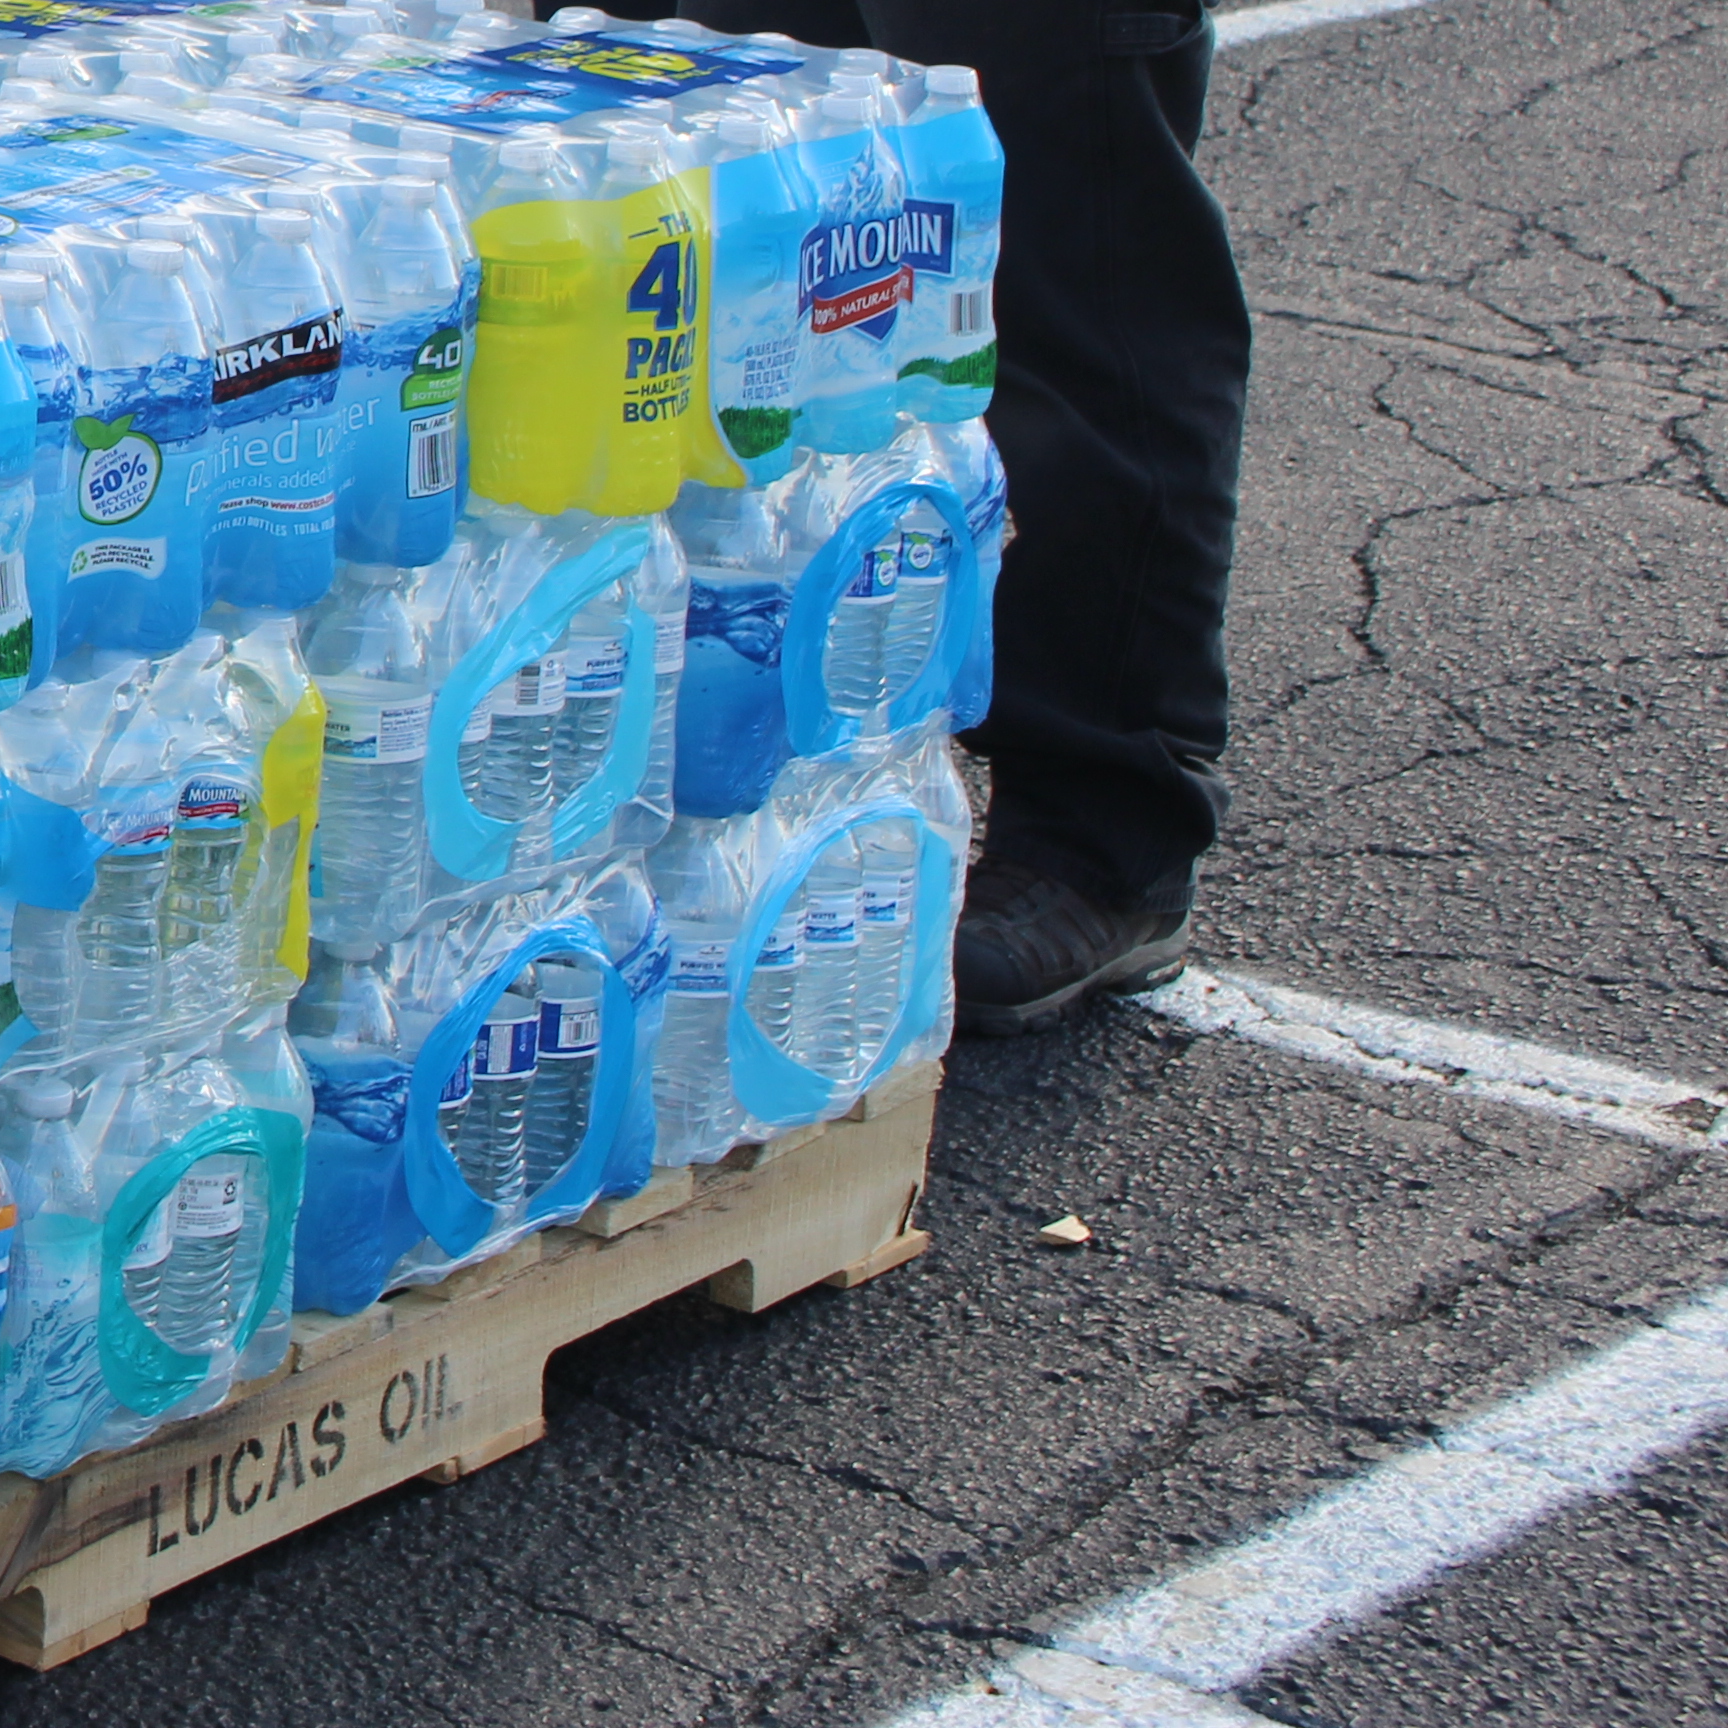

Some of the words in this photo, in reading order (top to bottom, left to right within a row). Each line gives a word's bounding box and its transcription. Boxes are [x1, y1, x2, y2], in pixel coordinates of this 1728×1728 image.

[658, 211, 692, 238] THE
[799, 232, 824, 299] ICE
[626, 238, 698, 332] 40
[839, 285, 891, 317] NATURAL
[417, 339, 463, 369] 40
[624, 335, 695, 380] PACK!
[640, 379, 669, 397] HALF
[623, 391, 691, 424] BOTTLES
[108, 451, 128, 466] WITH
[88, 452, 148, 502] 50%
[278, 469, 325, 490] added
[95, 478, 148, 512] RECYCLED
[101, 492, 146, 518] PLASTIC
[245, 495, 269, 508] shop
[247, 515, 287, 537] BOTTLES
[293, 522, 321, 535] TOTAL
[110, 544, 143, 554] PACKAGE
[143, 546, 150, 554] IS
[92, 556, 115, 566] PLEASE
[115, 557, 152, 570] RECYCLE.
[679, 960, 714, 972] PURIFIED
[146, 1400, 347, 1557] LUCAS
[379, 1353, 463, 1444] OIL
